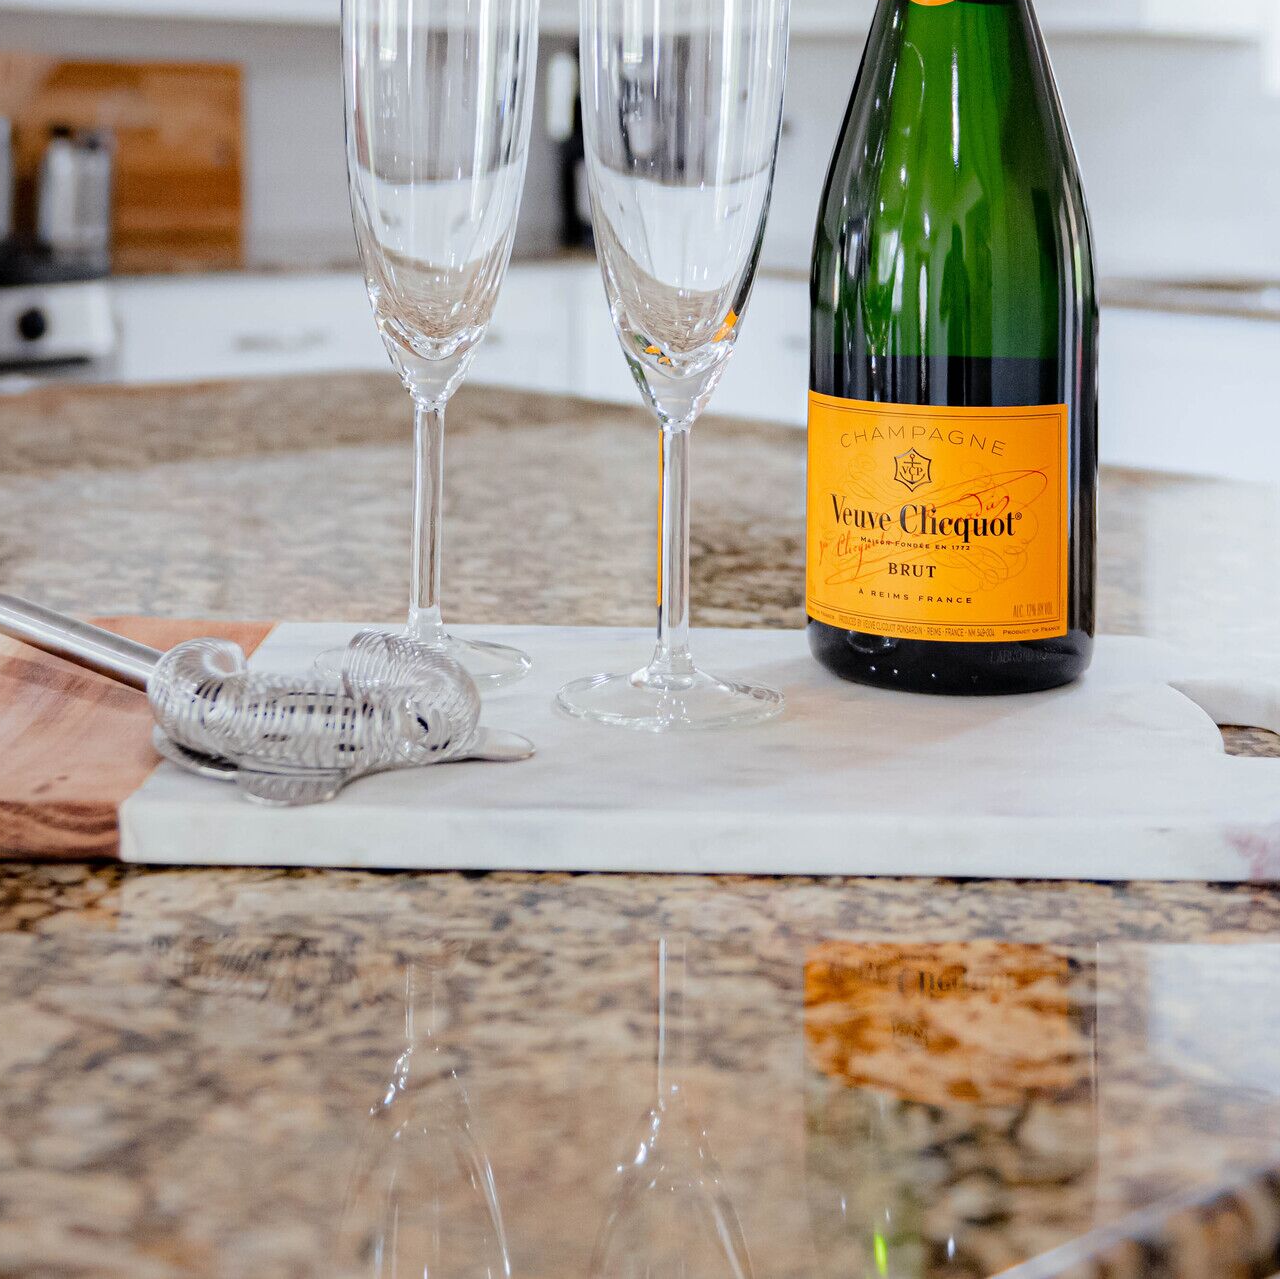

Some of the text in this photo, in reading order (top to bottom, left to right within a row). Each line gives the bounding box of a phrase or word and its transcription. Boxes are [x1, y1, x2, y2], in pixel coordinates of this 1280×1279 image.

[840, 425, 1006, 456] CHAMPAGNE
[830, 493, 891, 531] Veuve
[860, 536, 891, 546] MAISON
[888, 562, 937, 578] BRUT
[871, 590, 909, 601] REIMS
[918, 595, 972, 604] FRANCE
[897, 624, 923, 635] PONSARDIN
[945, 627, 964, 637] FRANCE
